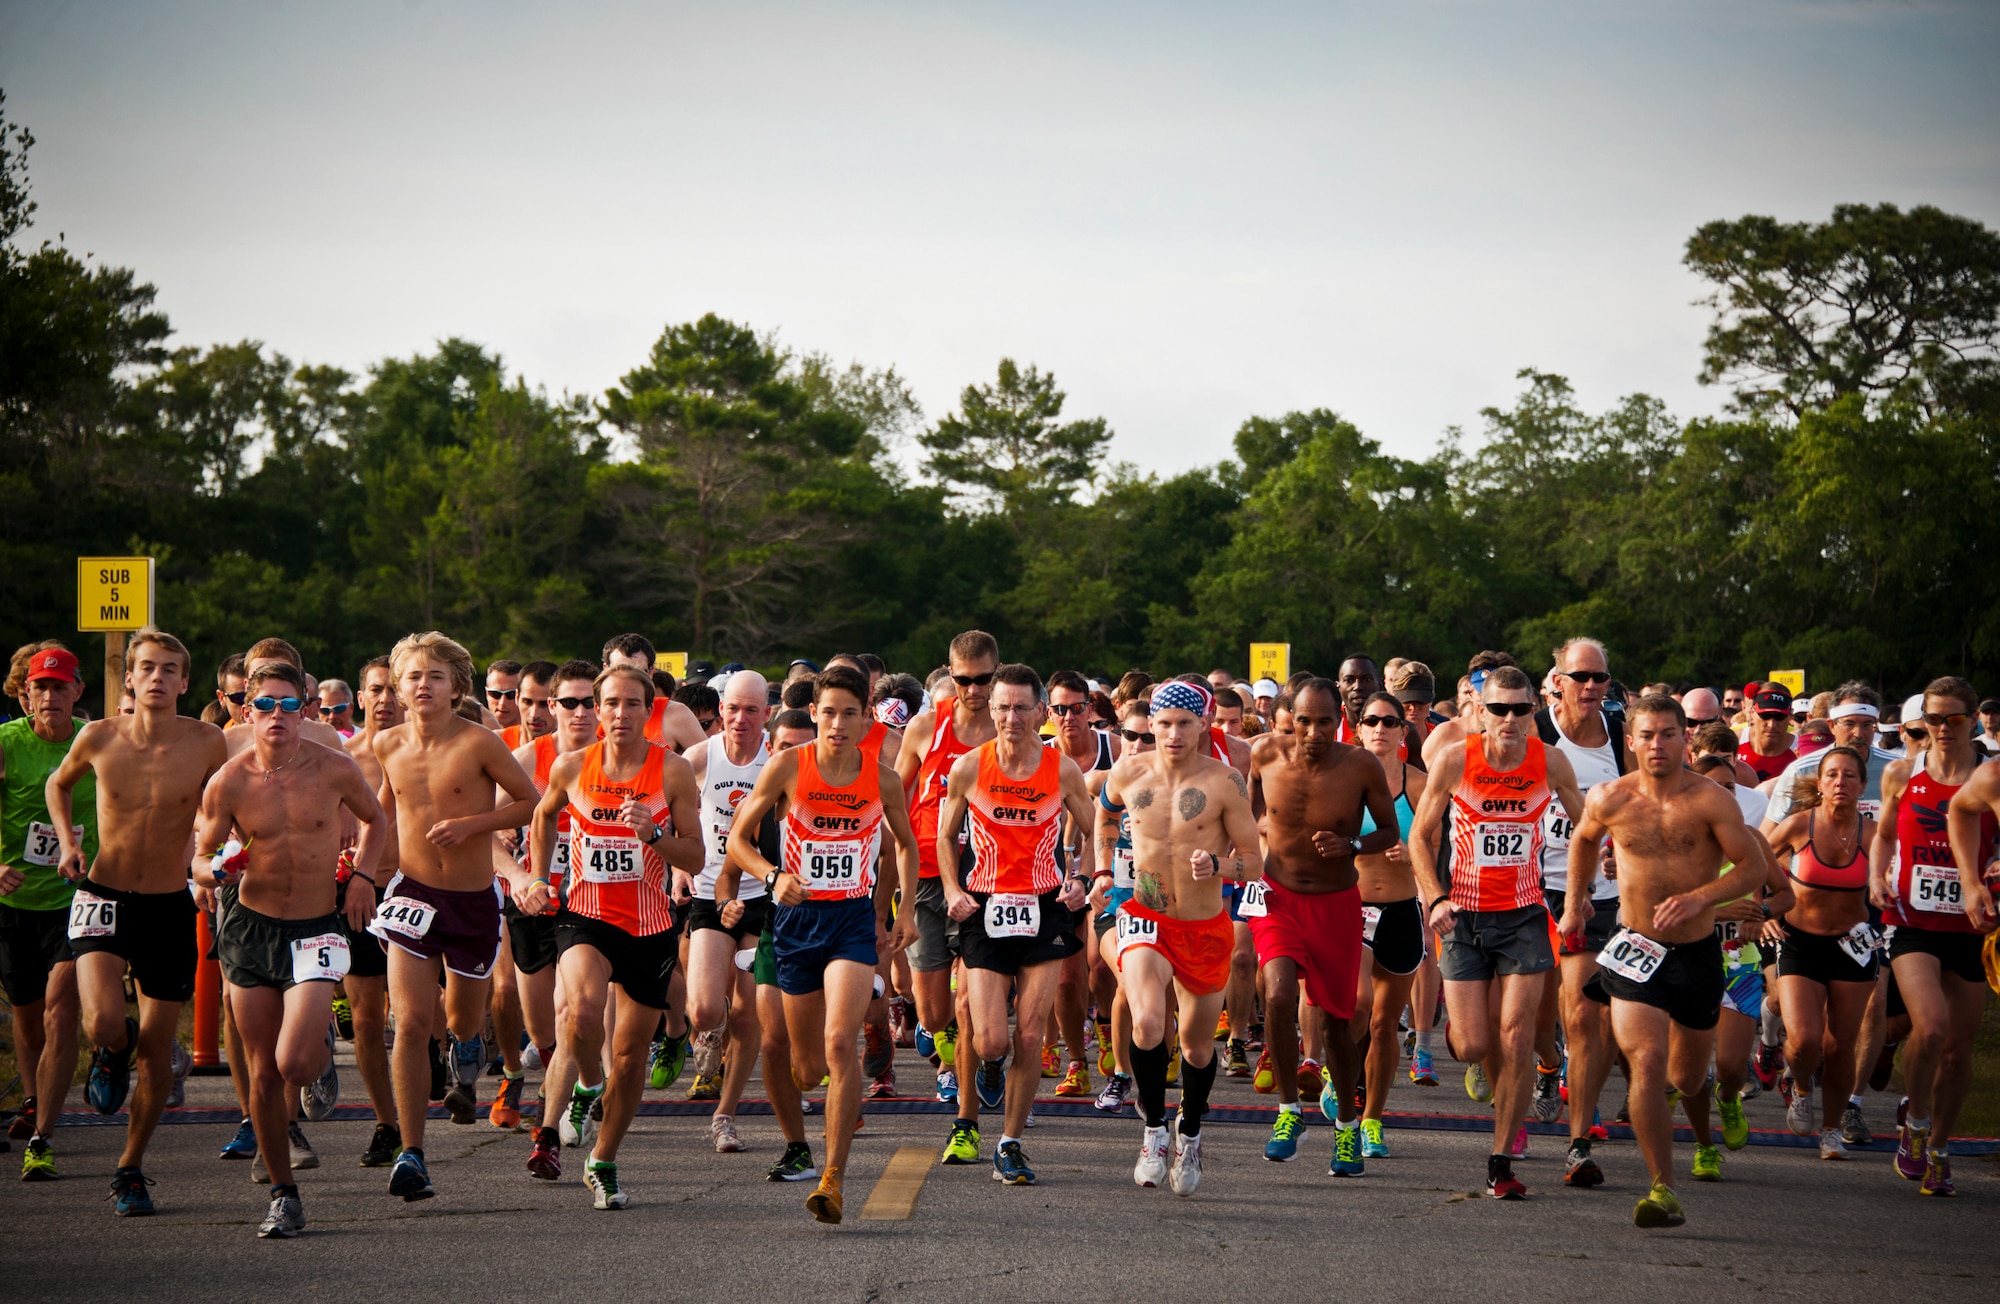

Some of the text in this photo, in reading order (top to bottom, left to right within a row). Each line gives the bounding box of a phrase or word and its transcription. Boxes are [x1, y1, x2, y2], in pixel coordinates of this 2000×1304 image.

[100, 569, 130, 585] SUB
[111, 587, 119, 603] 5
[100, 605, 130, 621] MIN
[1261, 650, 1277, 659] SUB
[1266, 660, 1272, 669] 7
[1261, 671, 1277, 679] MIN
[1779, 677, 1794, 685] SUB
[1771, 693, 1784, 702] TYR
[714, 780, 754, 791] GULF WIN
[1476, 775, 1524, 786] saucony
[589, 784, 635, 797] saucony
[989, 784, 1036, 797] saucony
[808, 791, 857, 804] saucony
[715, 806, 734, 818] TRAC
[1482, 800, 1527, 813] GWTC
[591, 808, 625, 821] GW
[993, 806, 1037, 822] GWTC
[813, 816, 861, 831] GWTC
[1486, 827, 1518, 835] Gate-to-Gate
[591, 842, 626, 850] Gate-to-Gate
[1483, 834, 1523, 856] 682
[590, 850, 634, 872] 485
[1912, 846, 1954, 864] RW
[810, 855, 853, 878] 959
[1923, 871, 1957, 880] Gate-to-Gate
[1919, 878, 1962, 903] 549
[71, 902, 114, 928] 276
[380, 905, 425, 927] 440
[992, 905, 1032, 927] 394
[303, 939, 348, 950] Gate-to-Gate Run
[318, 946, 331, 967] 5
[1606, 941, 1658, 974] 026
